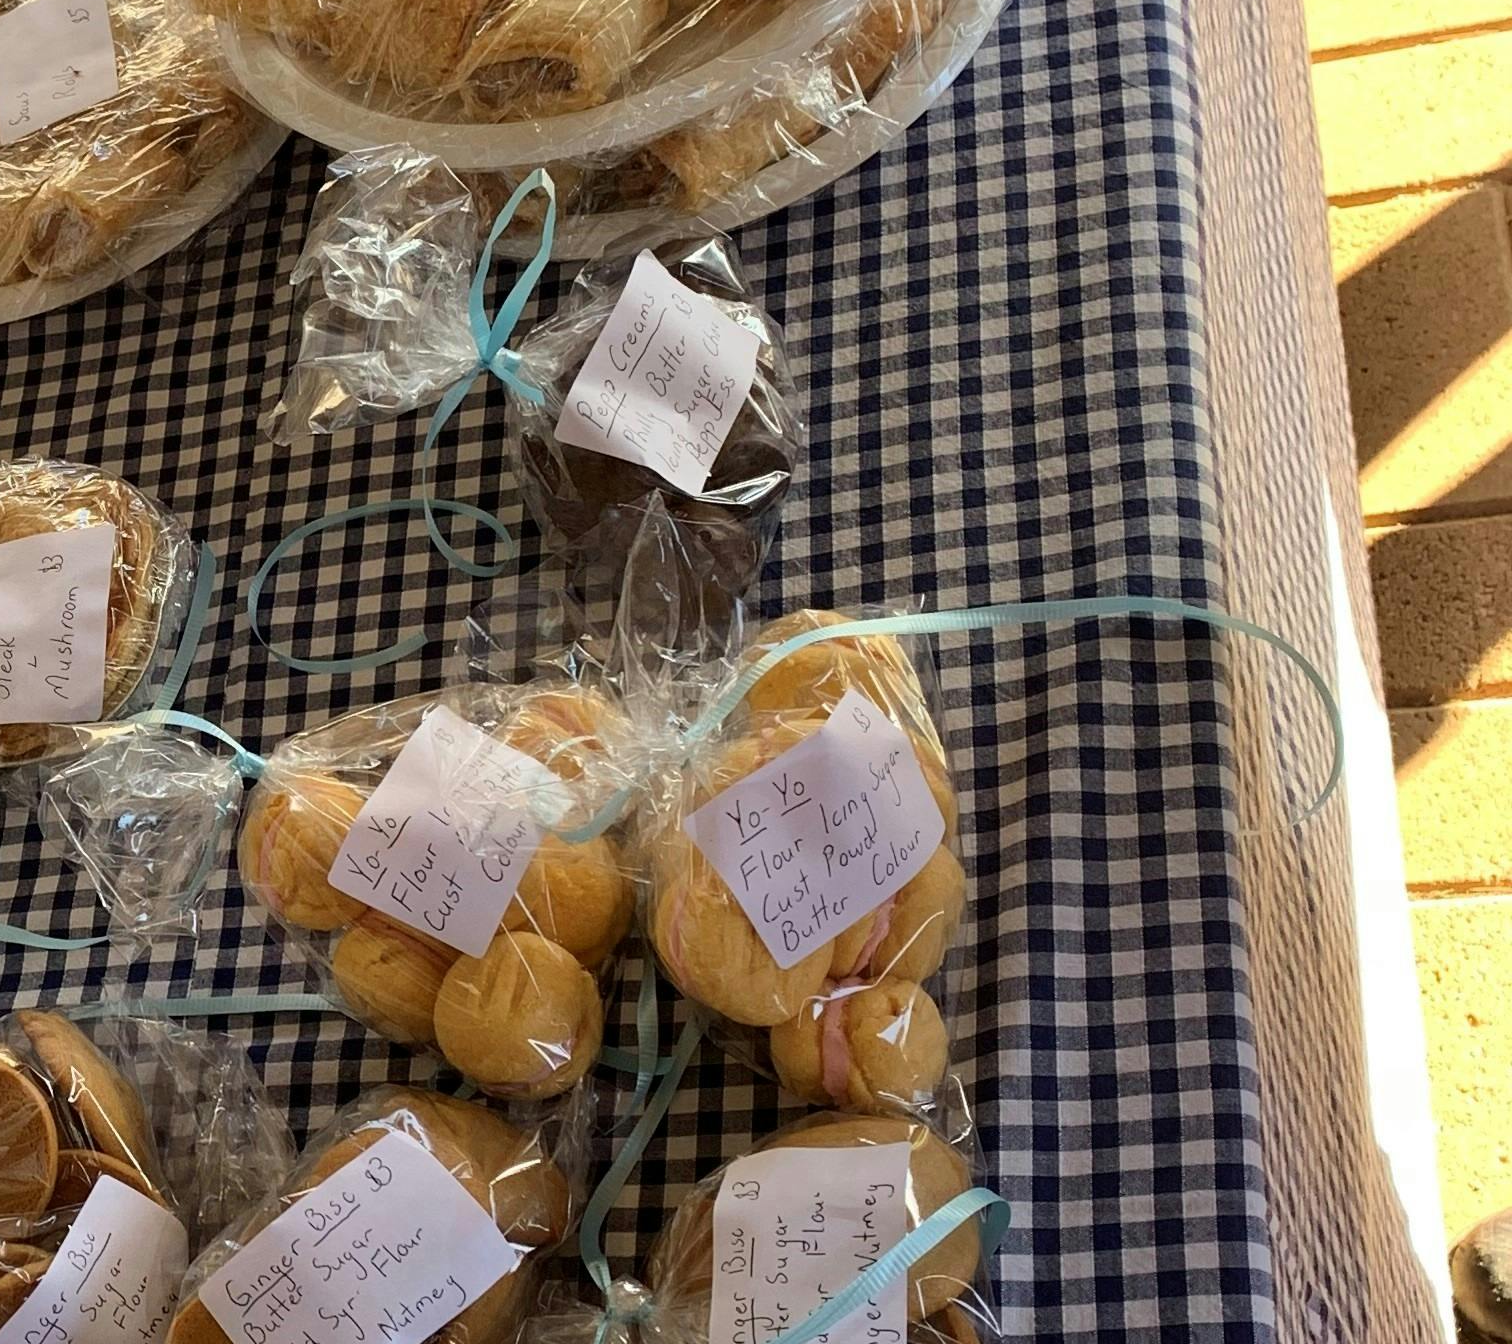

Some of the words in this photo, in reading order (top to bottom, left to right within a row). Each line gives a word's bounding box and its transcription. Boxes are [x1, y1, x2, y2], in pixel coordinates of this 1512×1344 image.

[52, 66, 76, 100] Rolls
[577, 380, 623, 430] Pepp
[609, 295, 655, 372] Creams
[645, 335, 686, 397] Butter
[674, 365, 712, 422] Sugar
[44, 587, 80, 700] Mushroom
[481, 820, 529, 883] Colour
[739, 838, 805, 890] Flour
[820, 793, 878, 834] Icing
[392, 845, 440, 912] Flour
[424, 869, 466, 932] Cust
[761, 870, 811, 924] Cust
[822, 828, 877, 878] Powd
[781, 895, 849, 952] Butter
[872, 829, 921, 886] Colour
[225, 1237, 302, 1308] Ginger
[312, 1229, 374, 1283] Sugar
[371, 1227, 425, 1278] Flour
[720, 1228, 746, 1274] Bisc
[377, 1275, 467, 1342] Nutmeg
